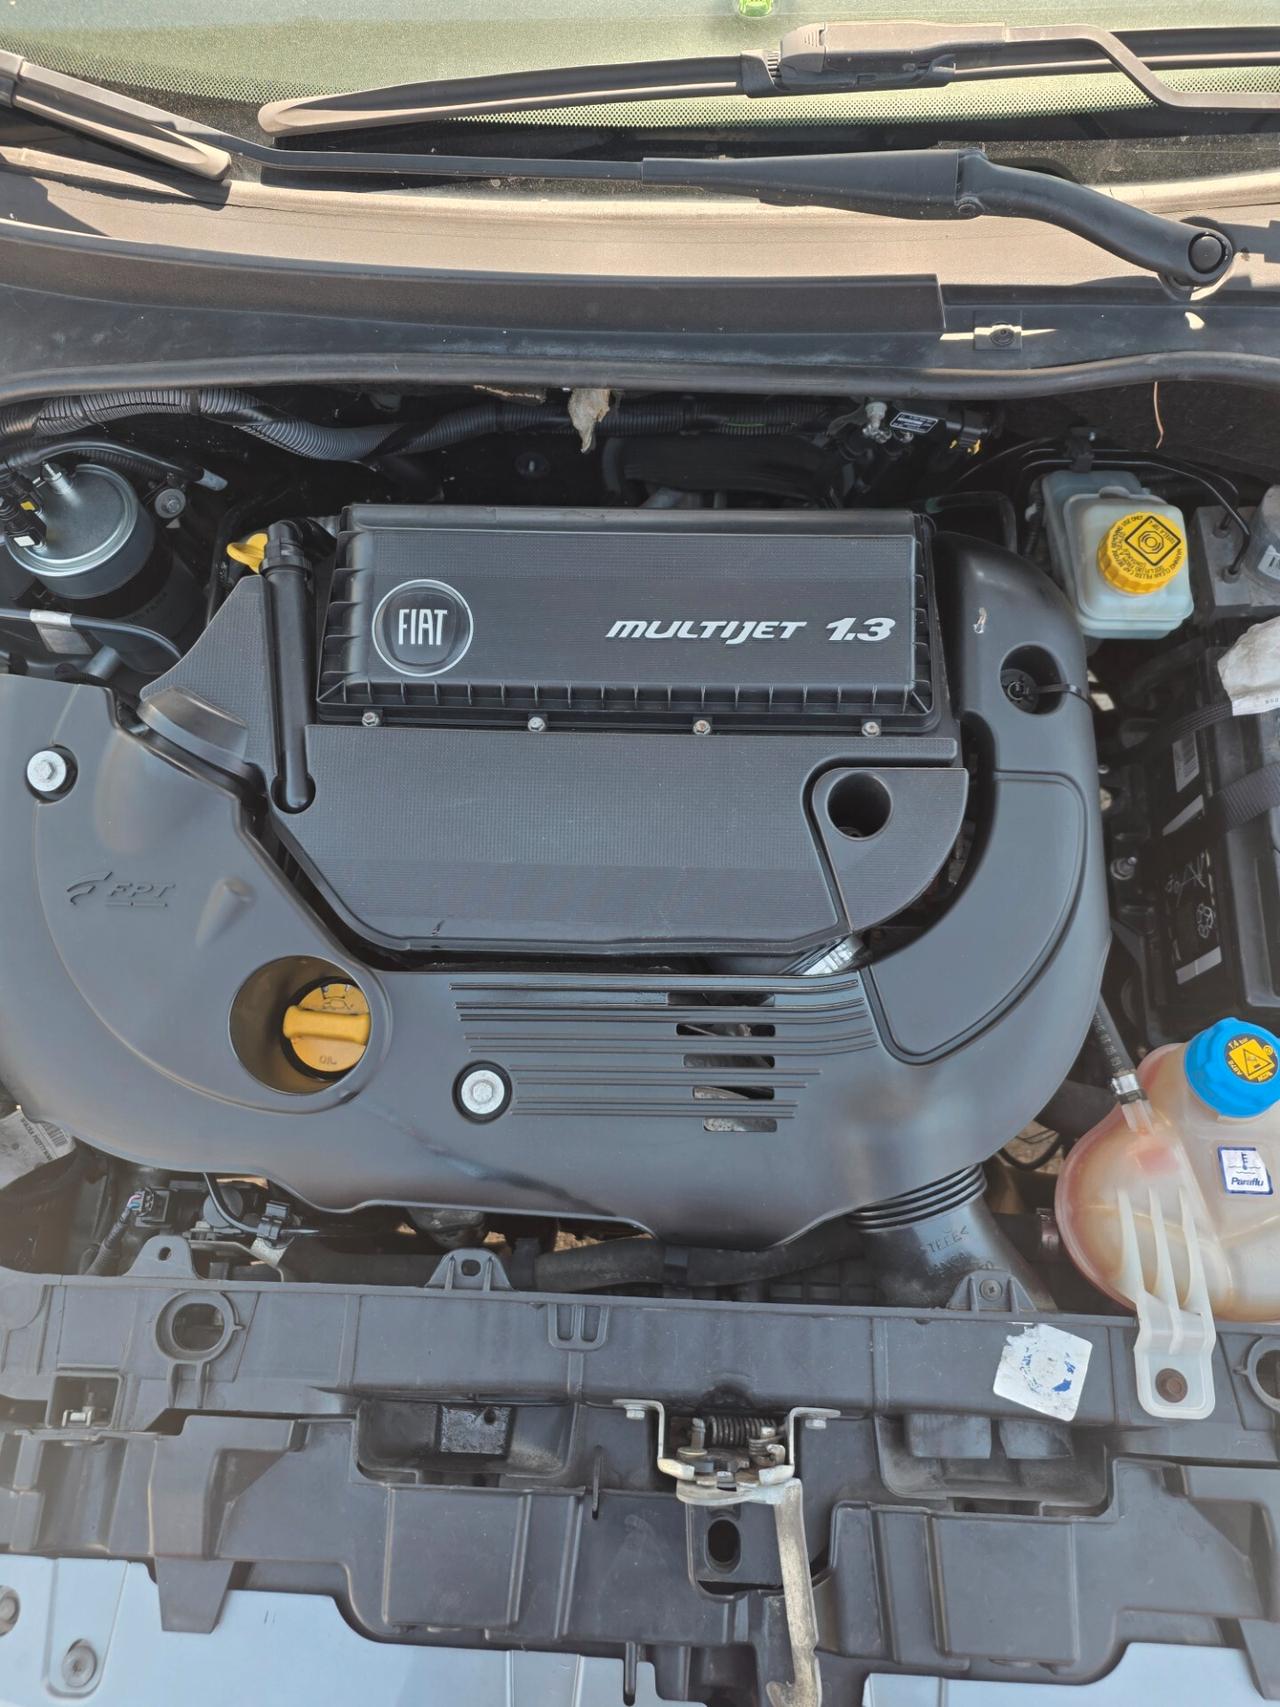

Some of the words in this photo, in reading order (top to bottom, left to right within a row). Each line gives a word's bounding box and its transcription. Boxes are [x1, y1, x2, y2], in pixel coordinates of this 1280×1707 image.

[398, 608, 448, 647] FIAT
[605, 620, 808, 646] MULTIJET
[825, 617, 897, 642] 1.3
[319, 1055, 337, 1066] OIL
[1230, 1176, 1265, 1188] Paraflu
